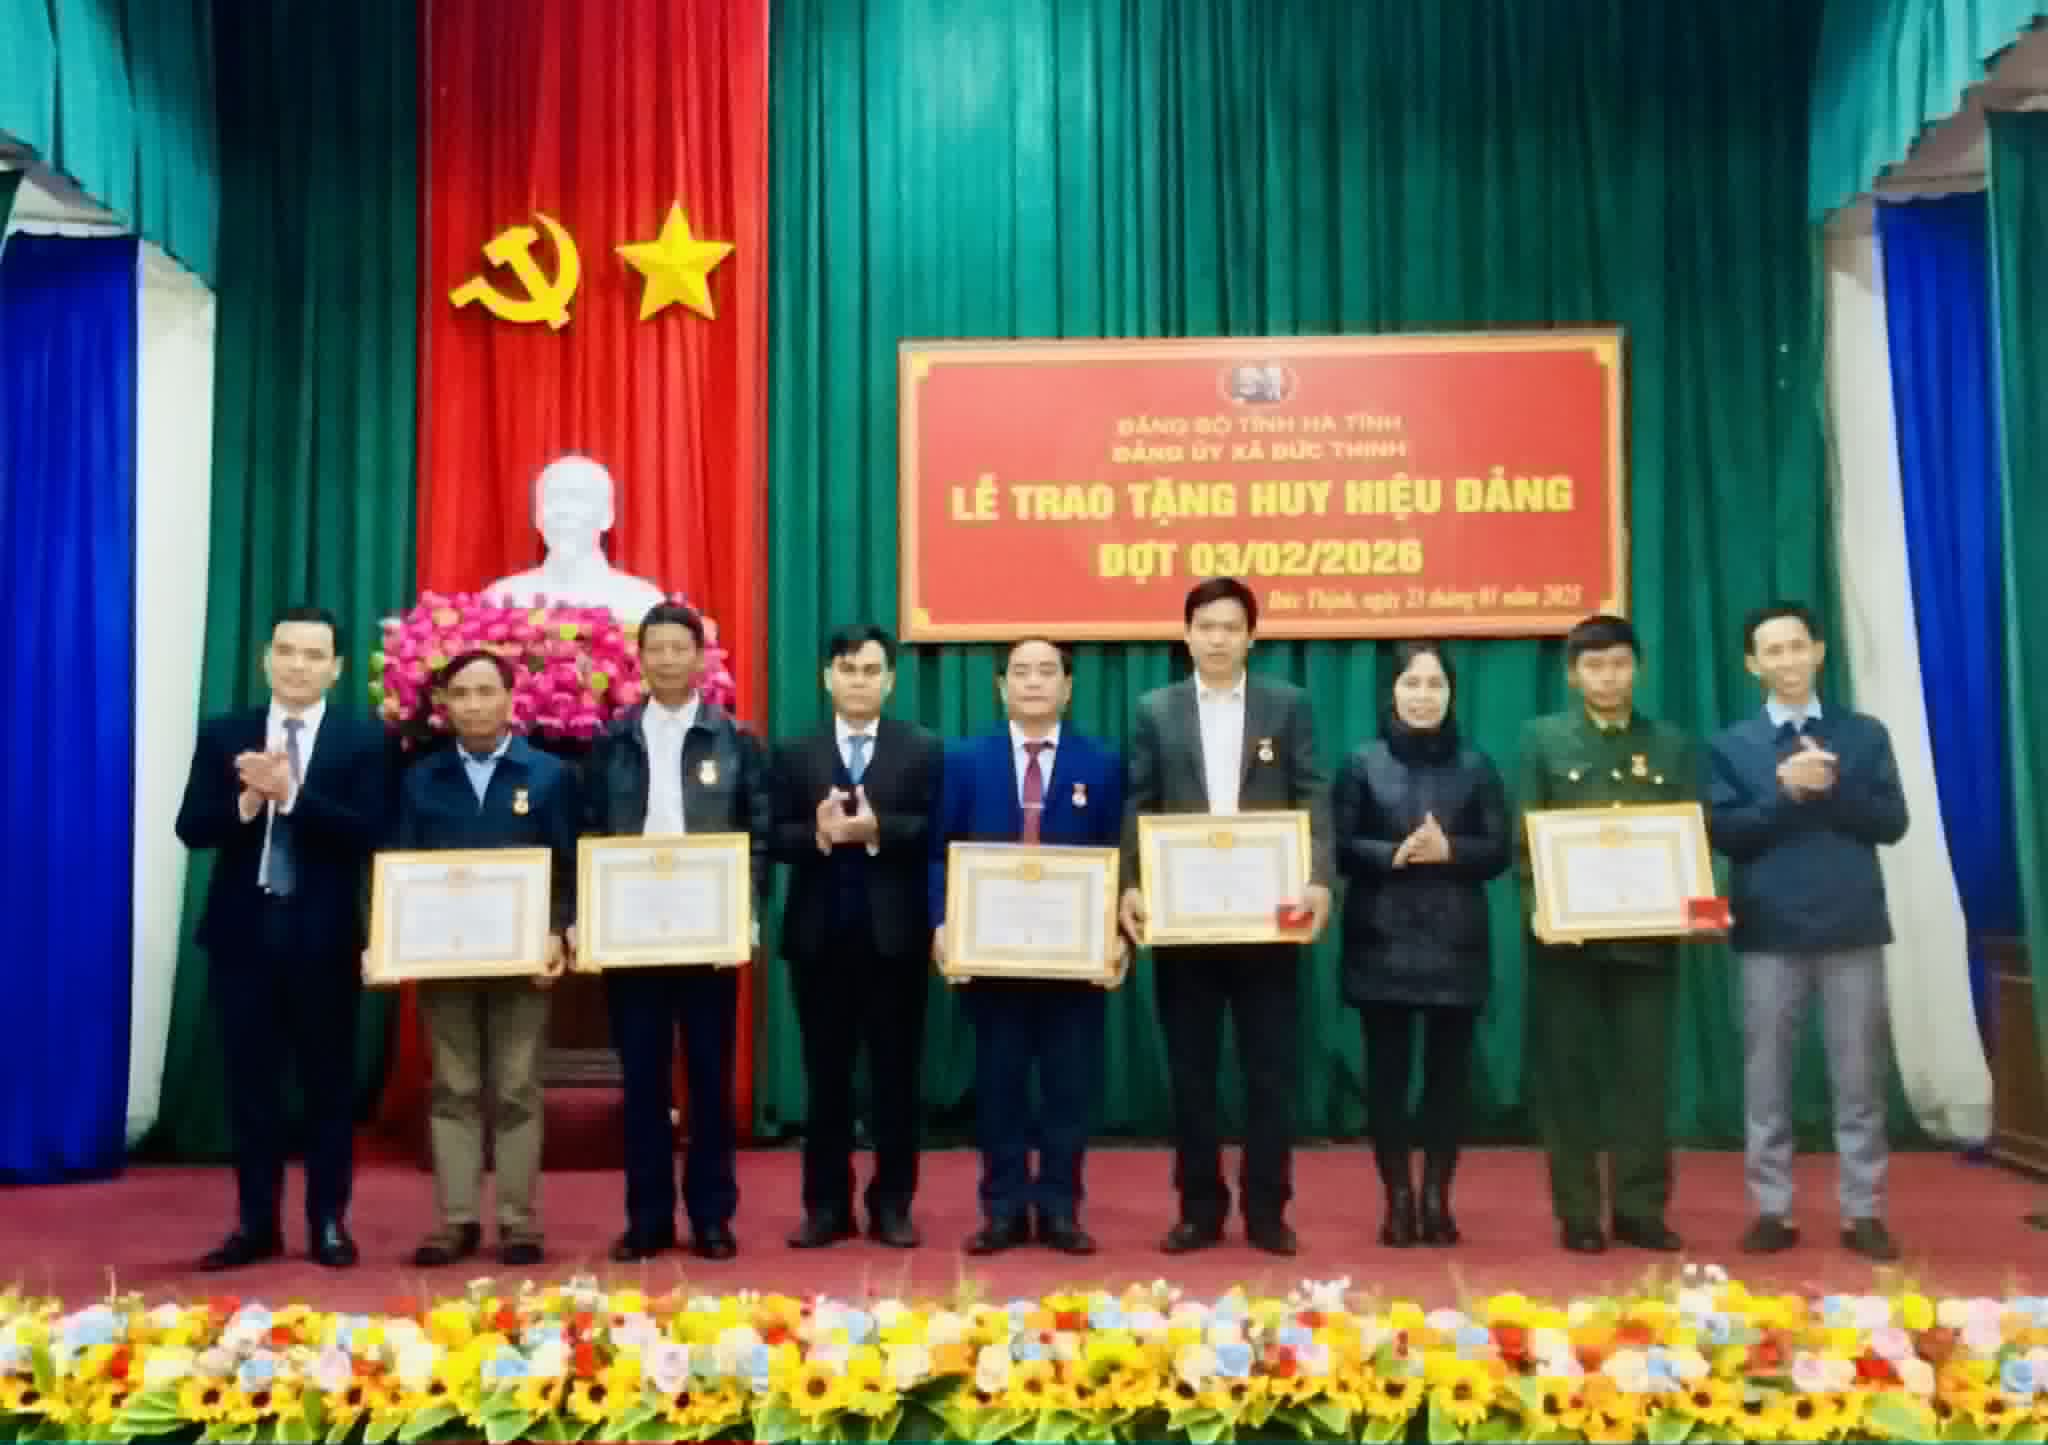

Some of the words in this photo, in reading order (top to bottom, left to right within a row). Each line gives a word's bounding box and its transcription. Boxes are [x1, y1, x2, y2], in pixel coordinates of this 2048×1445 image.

[952, 472, 999, 521] LỄ
[1010, 483, 1115, 521] TRAO
[1128, 476, 1237, 526] TẶNG
[1250, 478, 1332, 518] HUY
[1344, 471, 1441, 521] HIỆU
[1455, 465, 1574, 513] ĐẢNG
[1099, 539, 1177, 584] ĐỢT
[1190, 538, 1424, 577] 03/02/2026
